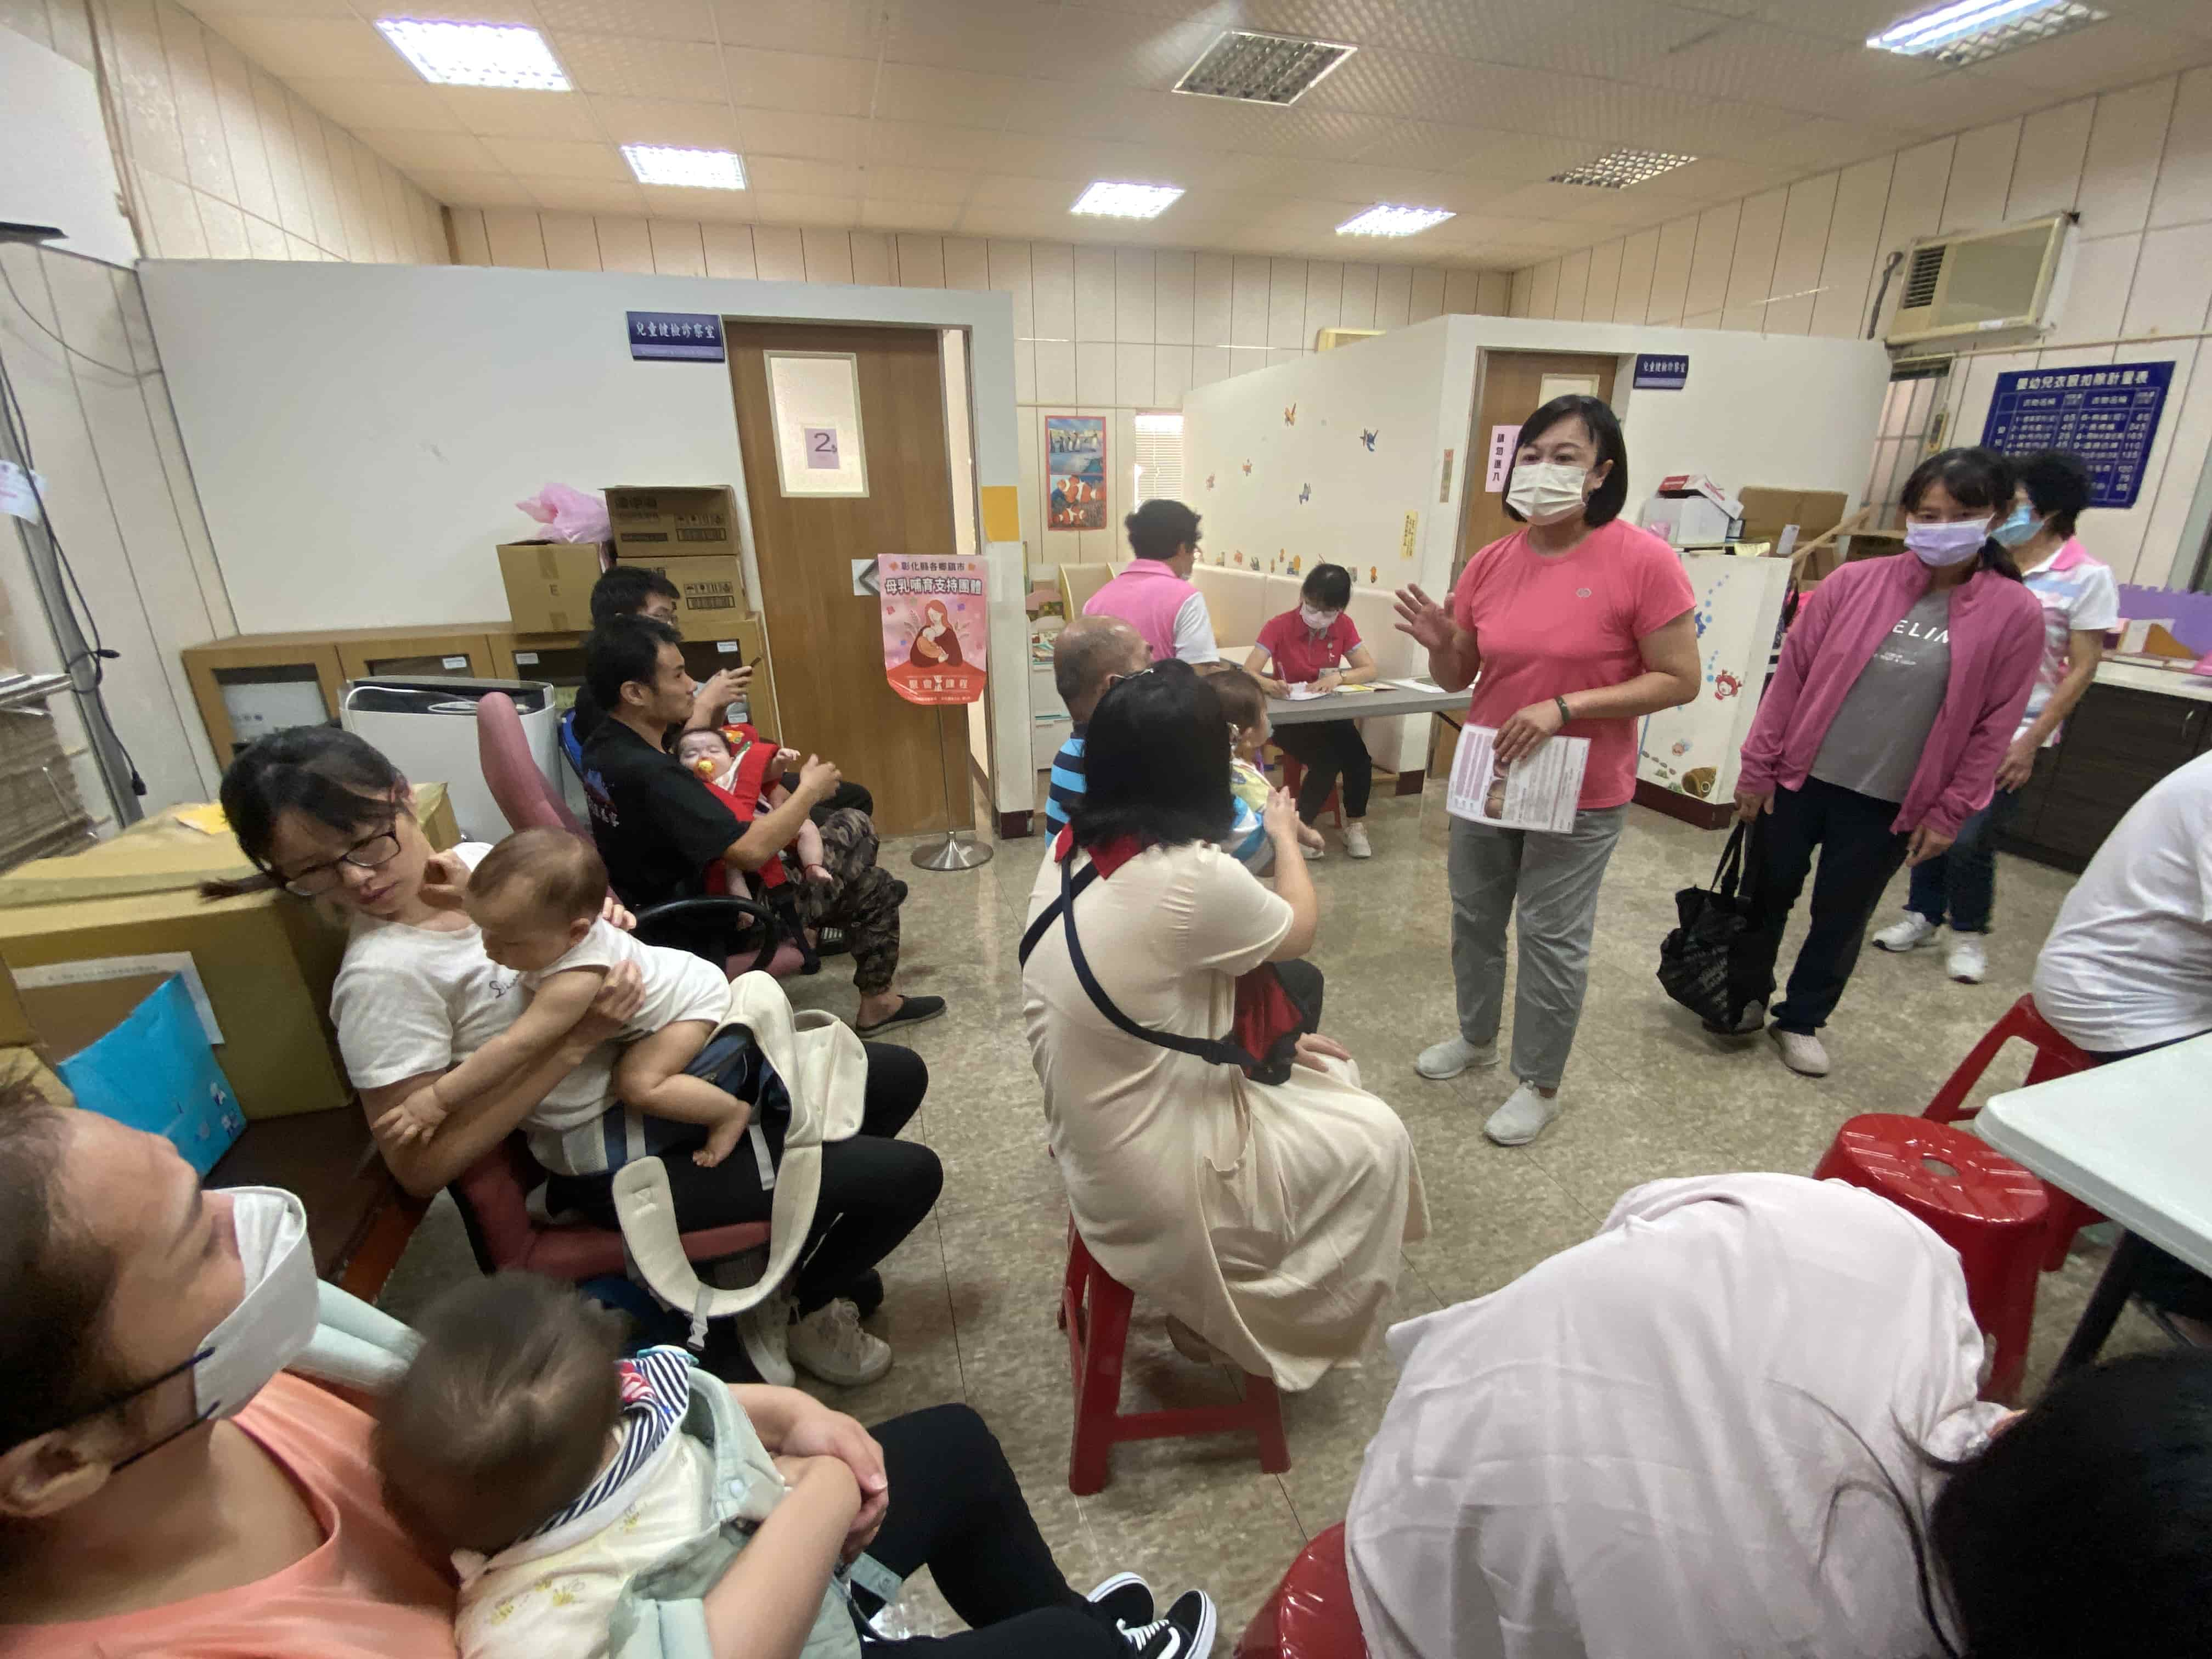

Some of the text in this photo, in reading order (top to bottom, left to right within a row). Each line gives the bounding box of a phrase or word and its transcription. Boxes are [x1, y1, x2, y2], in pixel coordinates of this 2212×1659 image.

[814, 433, 831, 452] 2
[901, 562, 965, 571] 彰化縣各鄉鎮市
[885, 577, 983, 595] 母乳哺育支持團體
